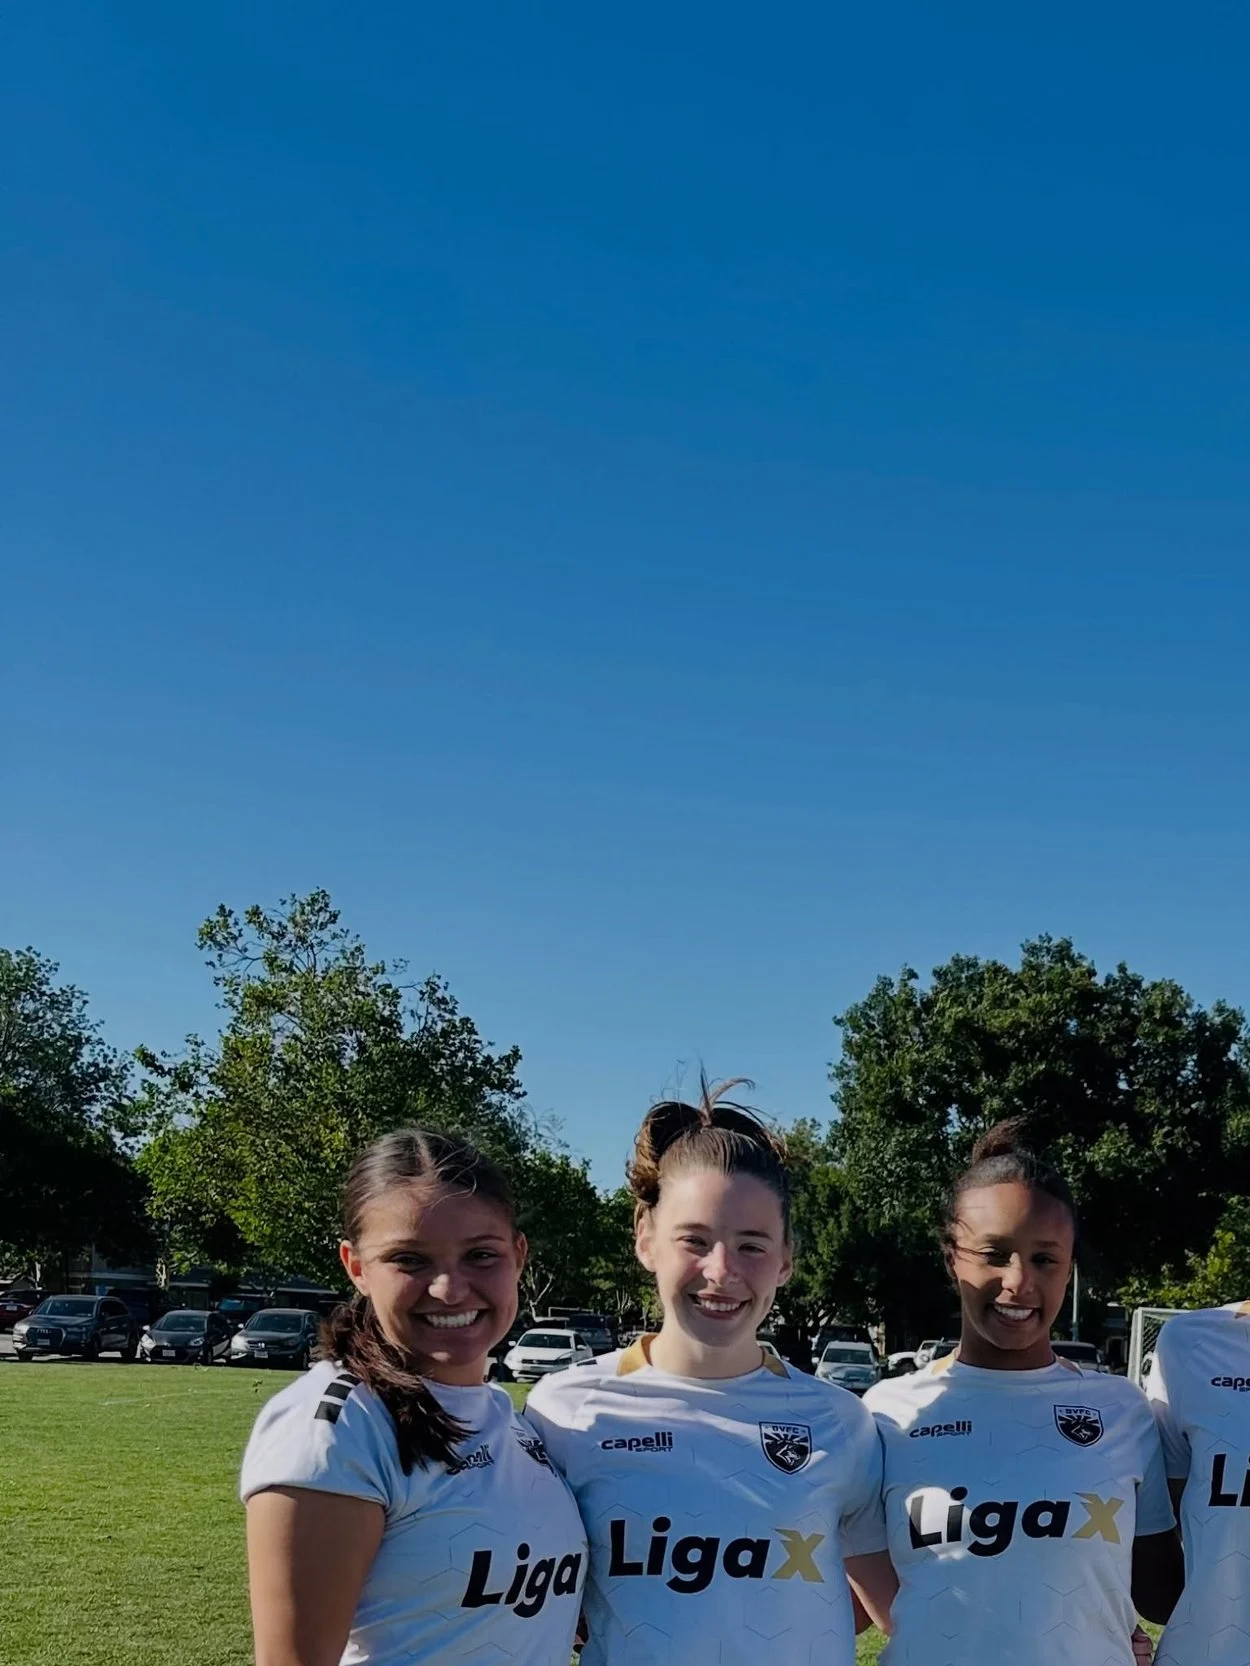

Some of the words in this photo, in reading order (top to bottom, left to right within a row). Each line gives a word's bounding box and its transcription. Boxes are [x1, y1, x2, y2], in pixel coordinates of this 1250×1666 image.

[908, 1420, 972, 1438] capelli
[601, 1431, 673, 1452] capelli
[461, 1542, 583, 1618] Liga
